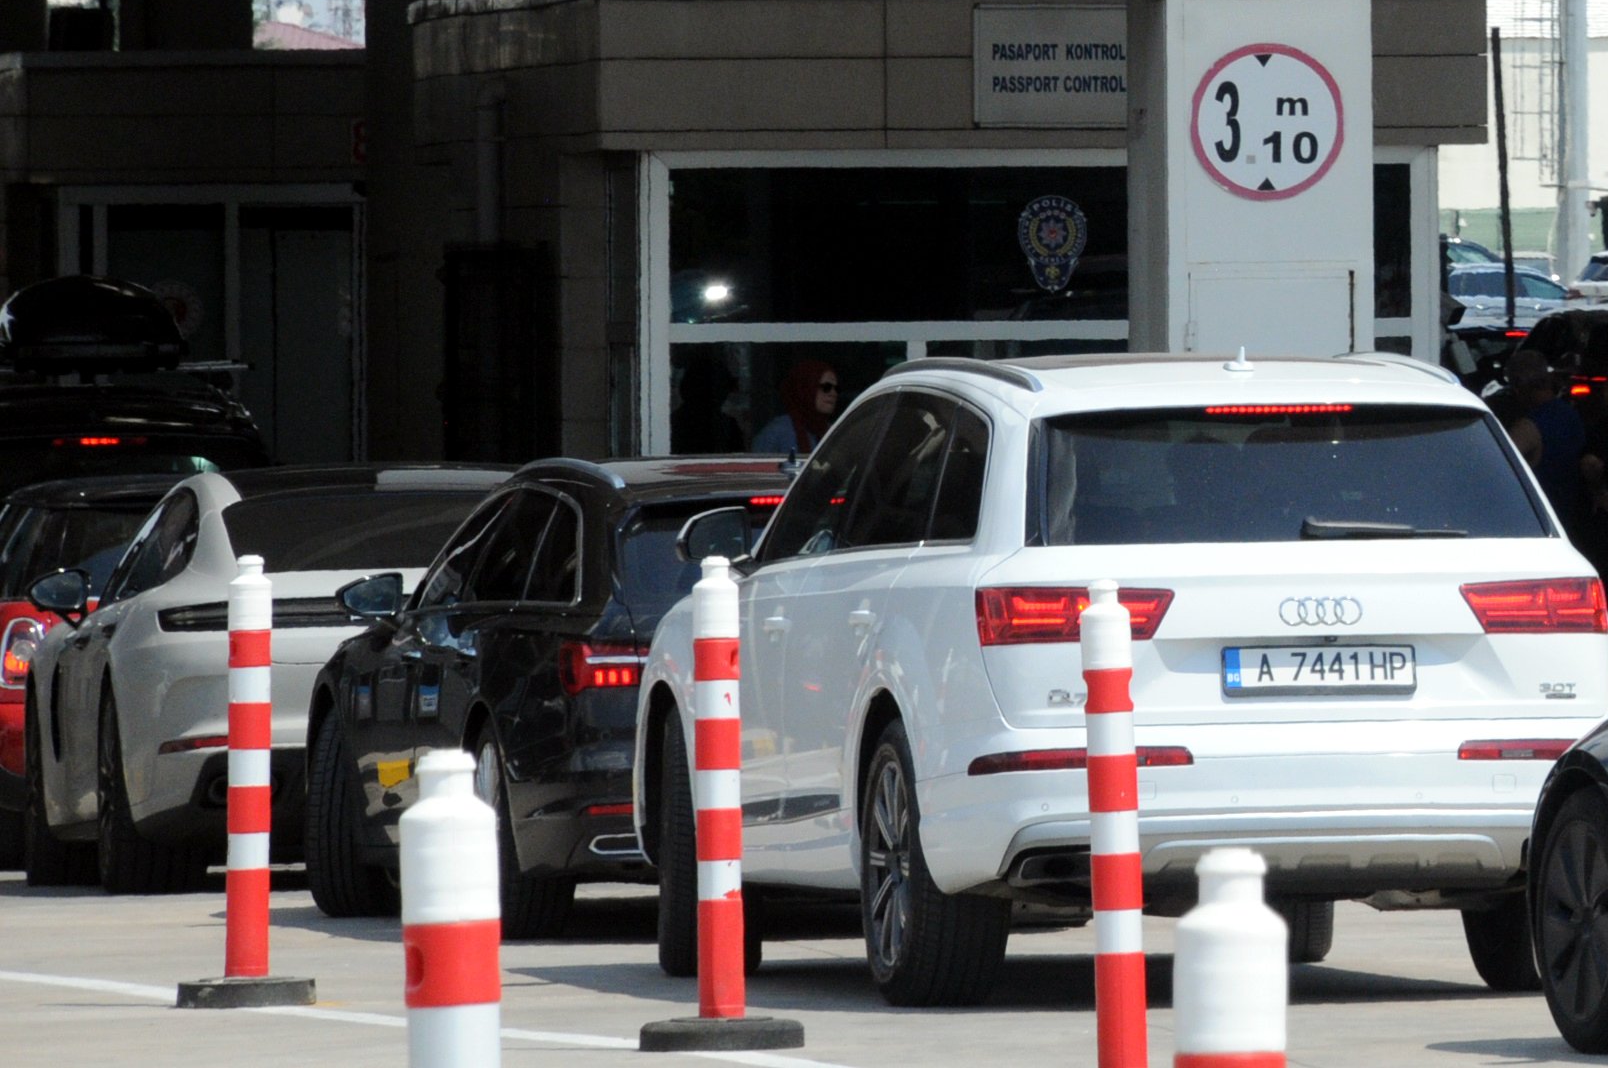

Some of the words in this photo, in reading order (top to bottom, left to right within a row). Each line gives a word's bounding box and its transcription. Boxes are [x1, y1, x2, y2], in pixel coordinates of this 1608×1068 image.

[991, 43, 1058, 61] PASAPORT
[1065, 43, 1126, 61] KONTROL
[991, 75, 1060, 93] PASSPORT
[1063, 75, 1126, 93] CONTROL
[1257, 653, 1274, 682] A
[1226, 673, 1240, 682] BG
